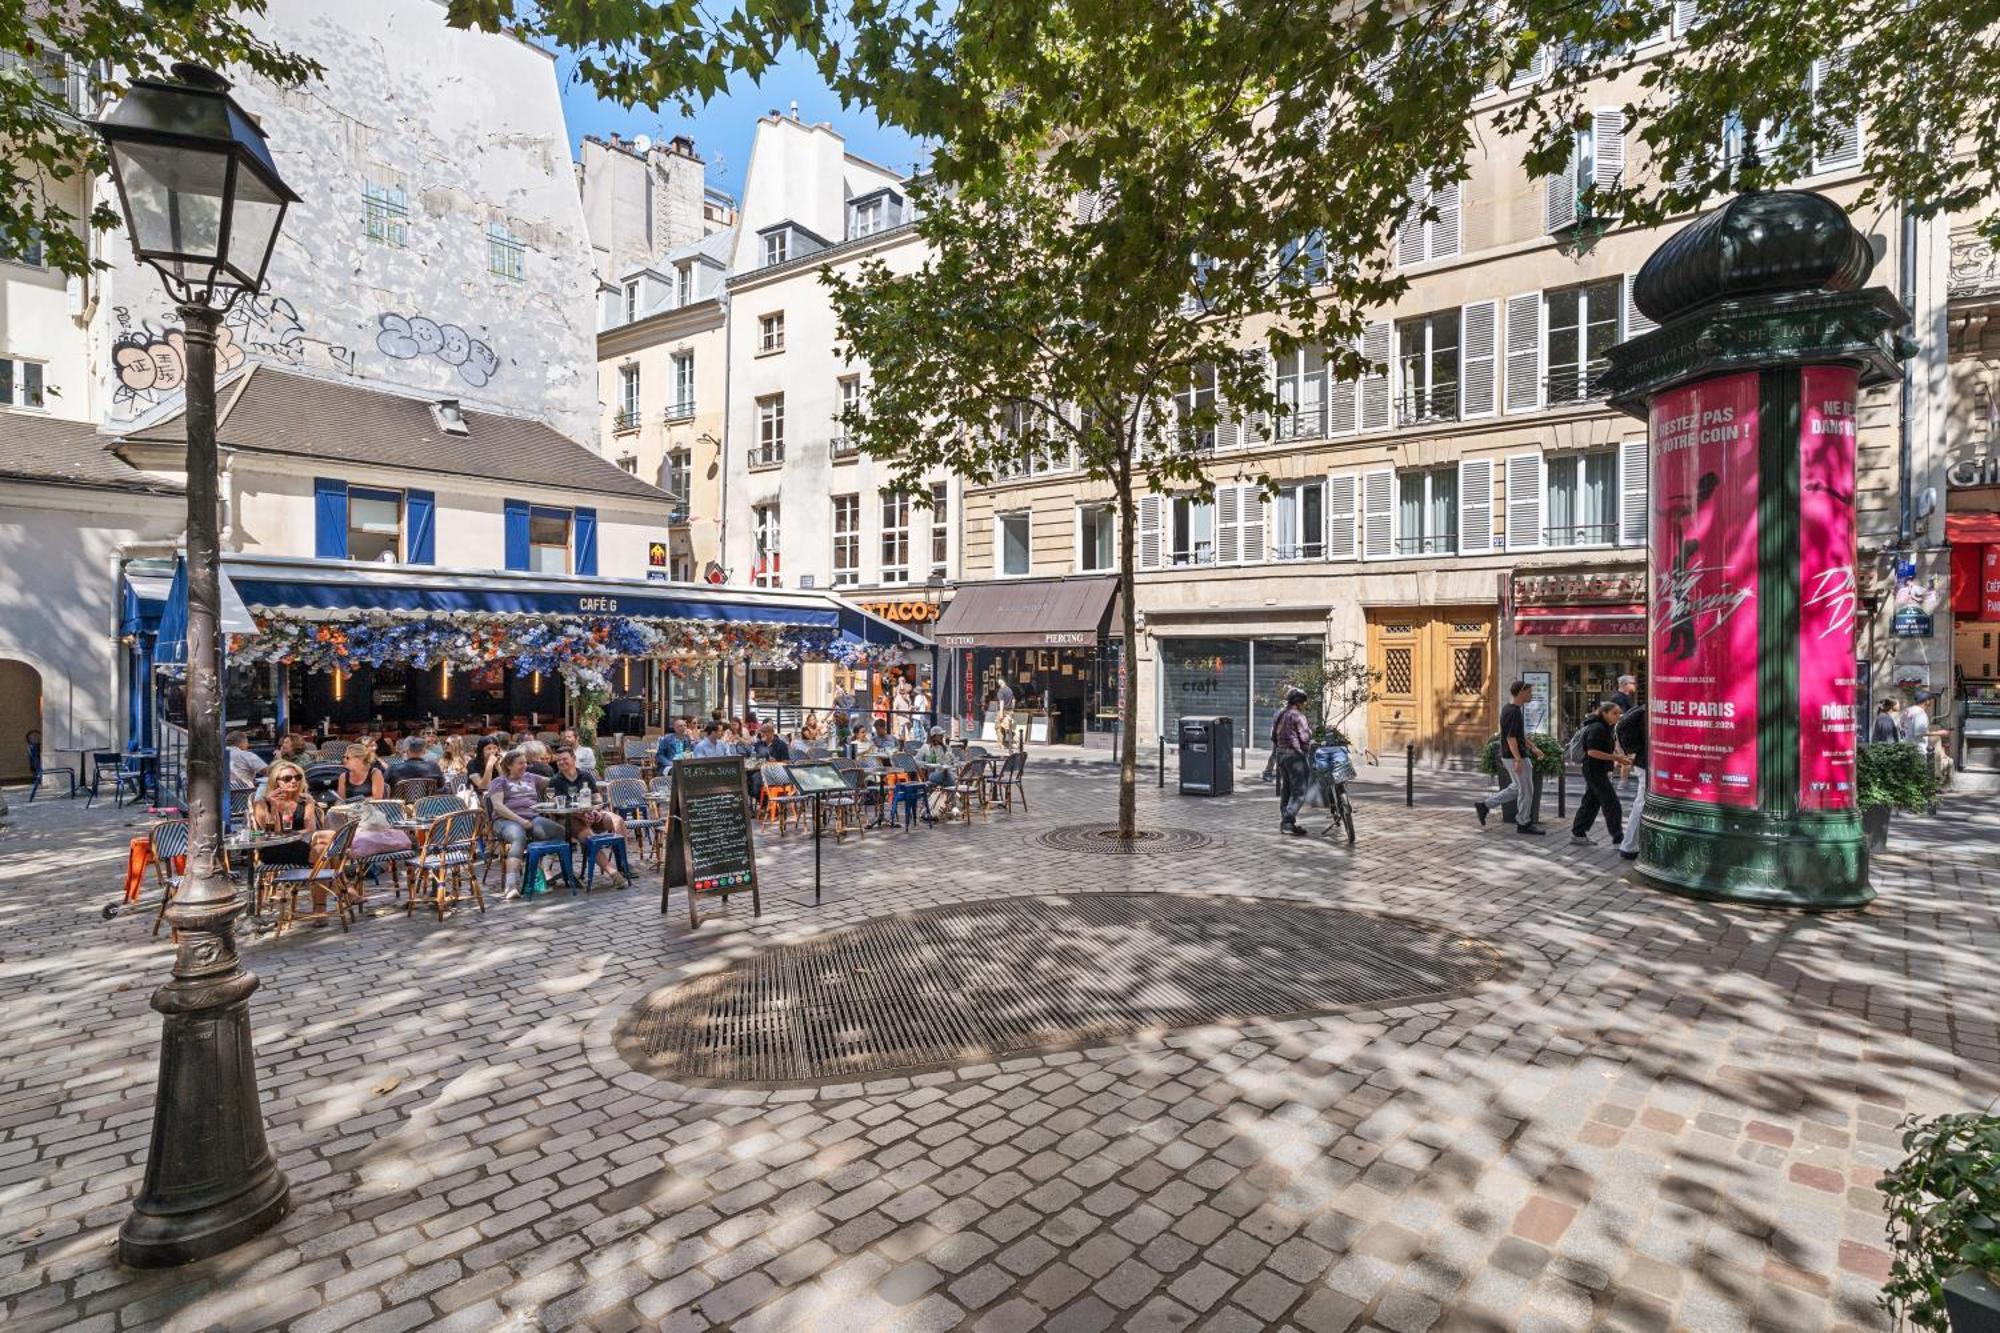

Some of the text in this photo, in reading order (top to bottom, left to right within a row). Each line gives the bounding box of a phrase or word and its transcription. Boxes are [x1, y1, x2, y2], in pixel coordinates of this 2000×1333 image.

[1738, 320, 1845, 343] SPECTACLES
[1659, 414, 1698, 437] RESTEZ
[1704, 407, 1734, 426] PAS
[1662, 432, 1696, 455] VOTRE
[1700, 425, 1738, 444] COIN
[580, 597, 617, 611] CAFÉ G
[1610, 623, 1647, 633] TABA
[1046, 633, 1083, 643] PIERCING
[1182, 677, 1218, 696] craft
[1670, 701, 1684, 715] DE
[1688, 701, 1735, 717] PARIS
[1822, 702, 1850, 720] DÔME
